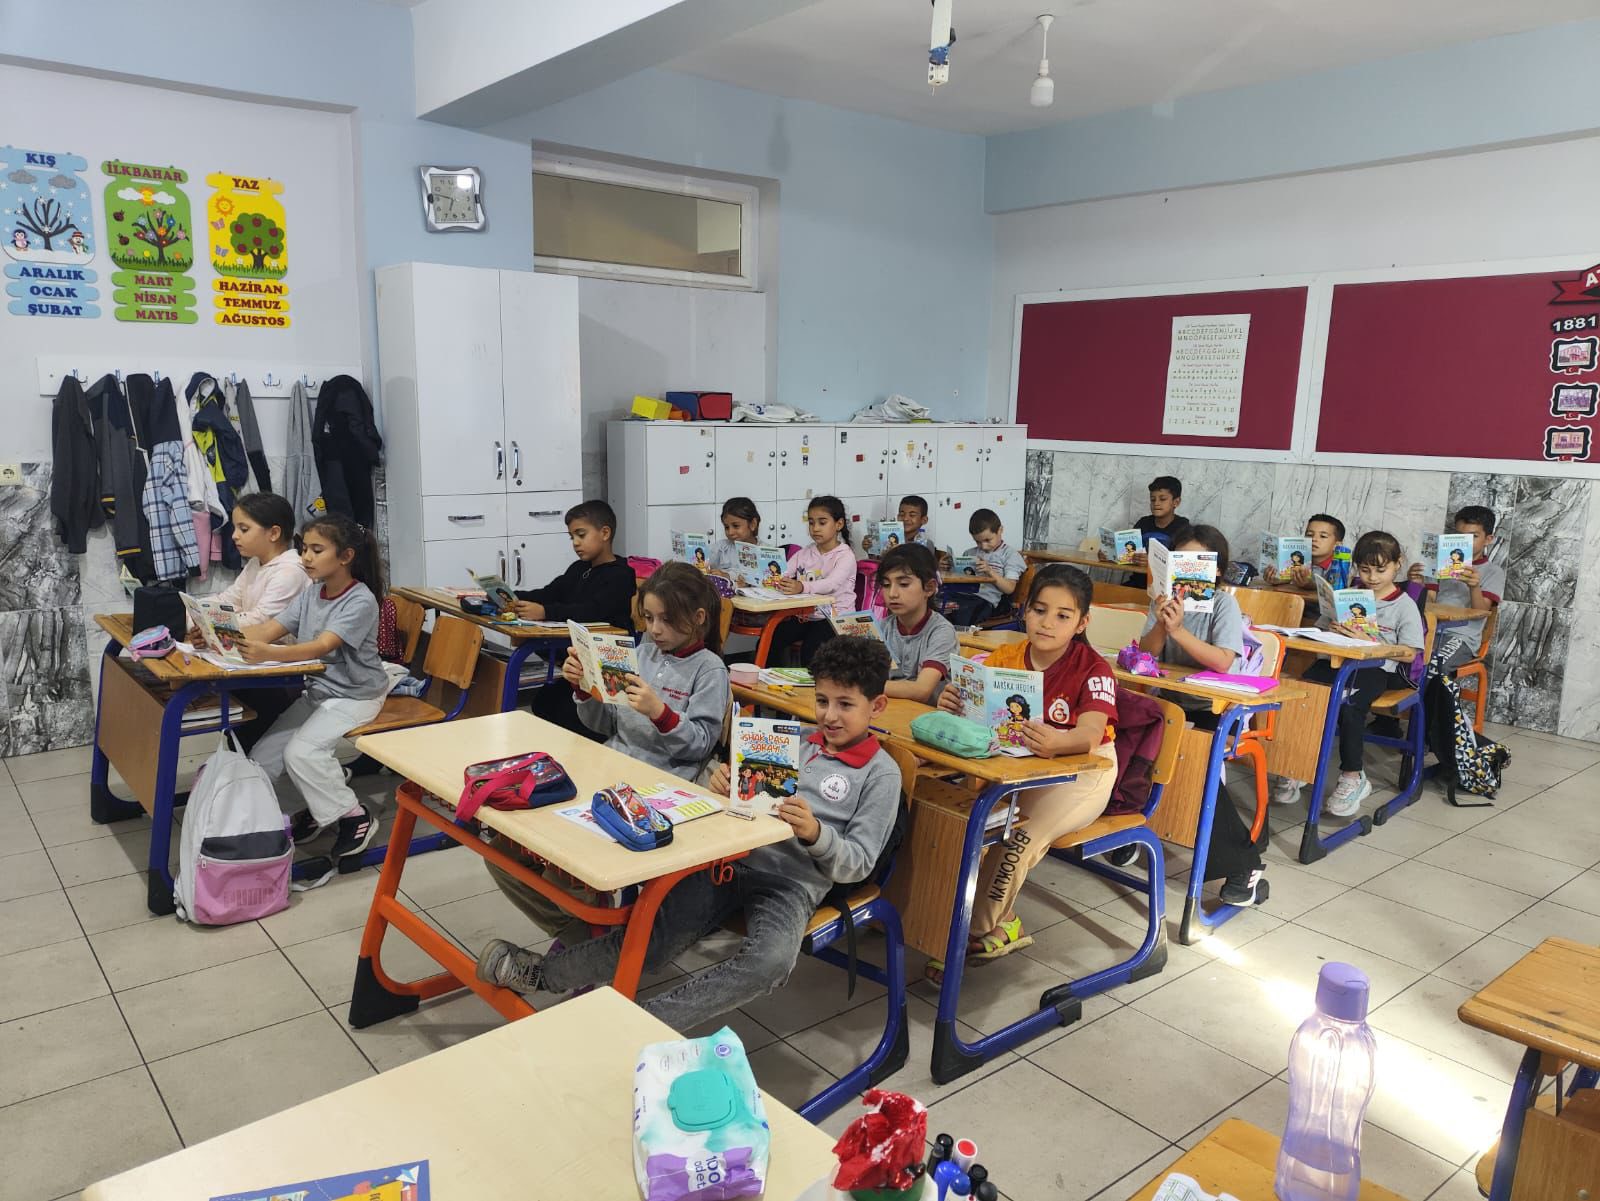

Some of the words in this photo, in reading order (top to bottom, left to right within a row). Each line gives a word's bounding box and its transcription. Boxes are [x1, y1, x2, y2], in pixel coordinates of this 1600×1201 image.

[26, 152, 56, 167] KIŞ
[106, 160, 183, 183] İLKBAHAR
[232, 177, 260, 191] YAZ
[19, 266, 85, 281] ARALIK
[134, 275, 174, 287] MART
[219, 280, 283, 295] HAZİRAN
[29, 285, 78, 298] OCAK
[134, 291, 177, 305] NİSAN
[27, 303, 83, 316] ŞUBAT
[223, 297, 282, 310] TEMMUZ
[135, 309, 178, 321] MAYIS
[222, 313, 285, 327] AĞUSTOS
[1553, 315, 1596, 332] 1881
[988, 832, 1031, 902] BROOKLYN
